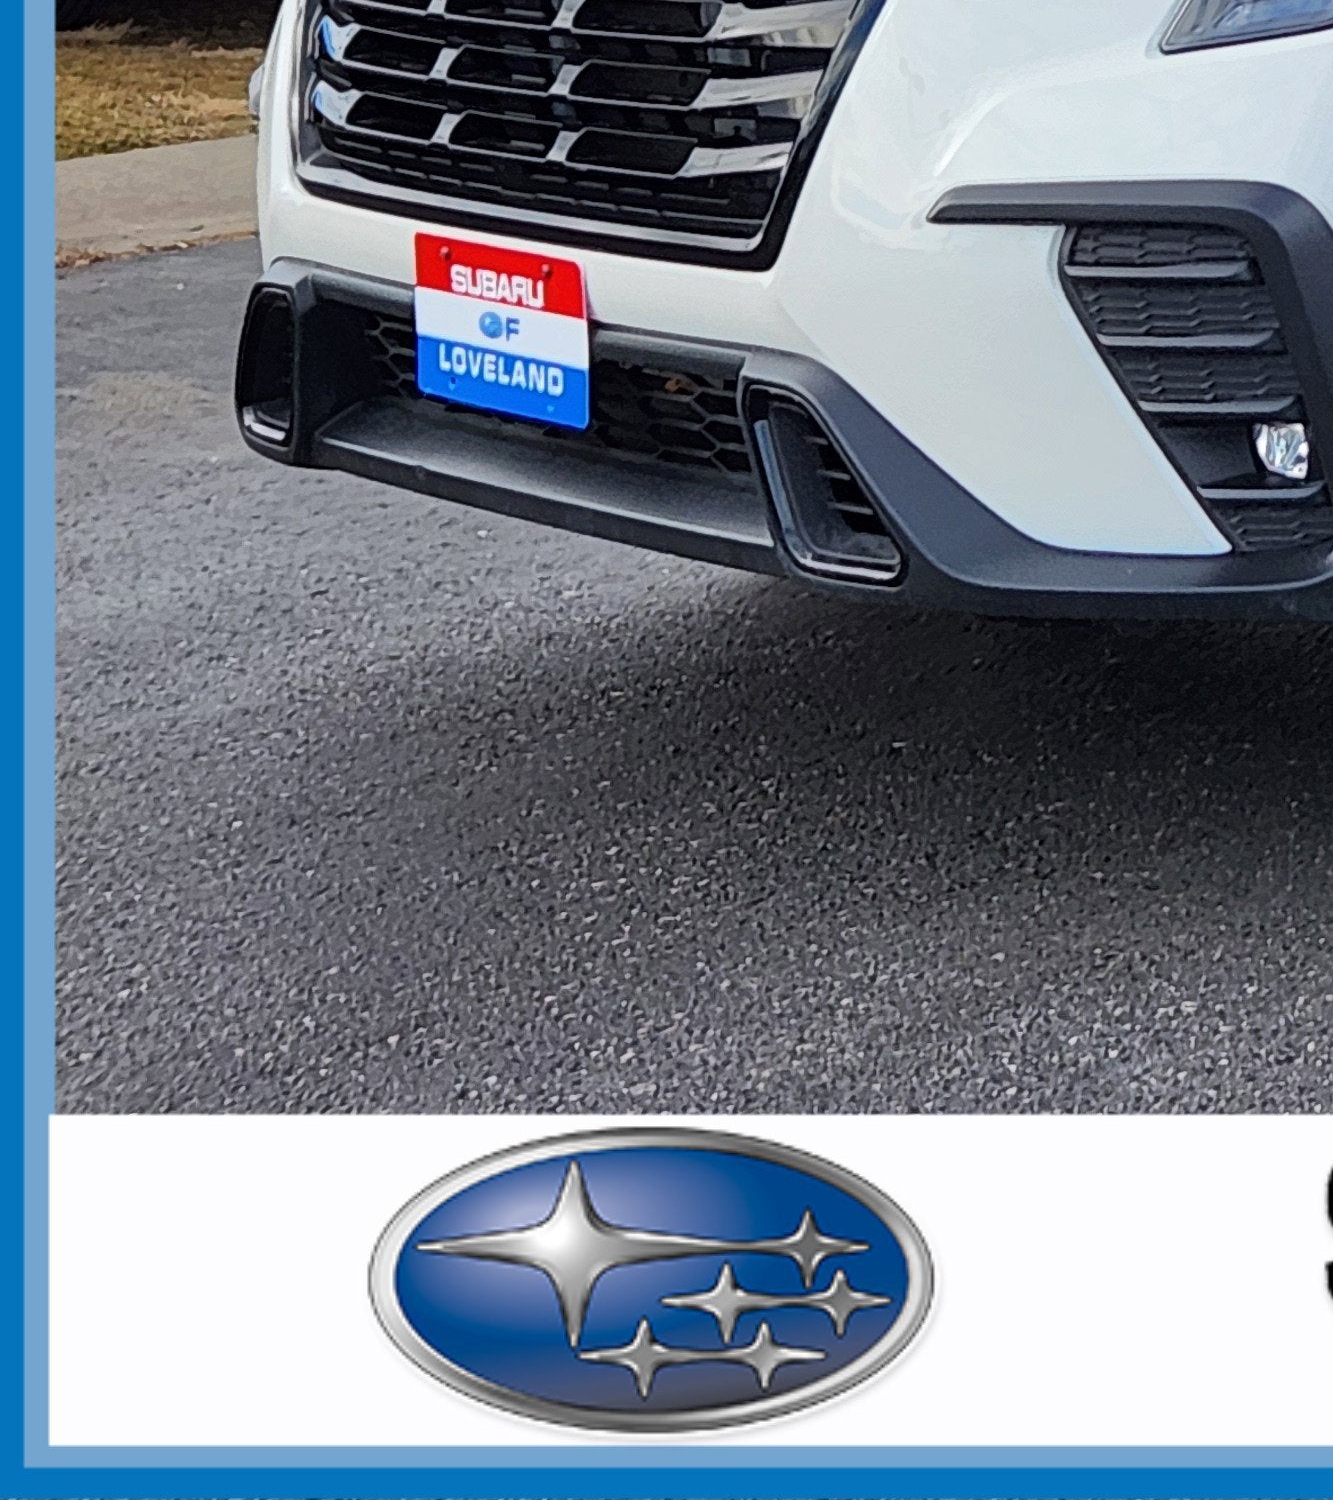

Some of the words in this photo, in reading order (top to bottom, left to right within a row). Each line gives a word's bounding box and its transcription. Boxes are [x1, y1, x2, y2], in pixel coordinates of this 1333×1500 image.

[450, 263, 546, 309] SUBARU
[479, 311, 521, 342] OF
[438, 342, 565, 398] LOVELAND
